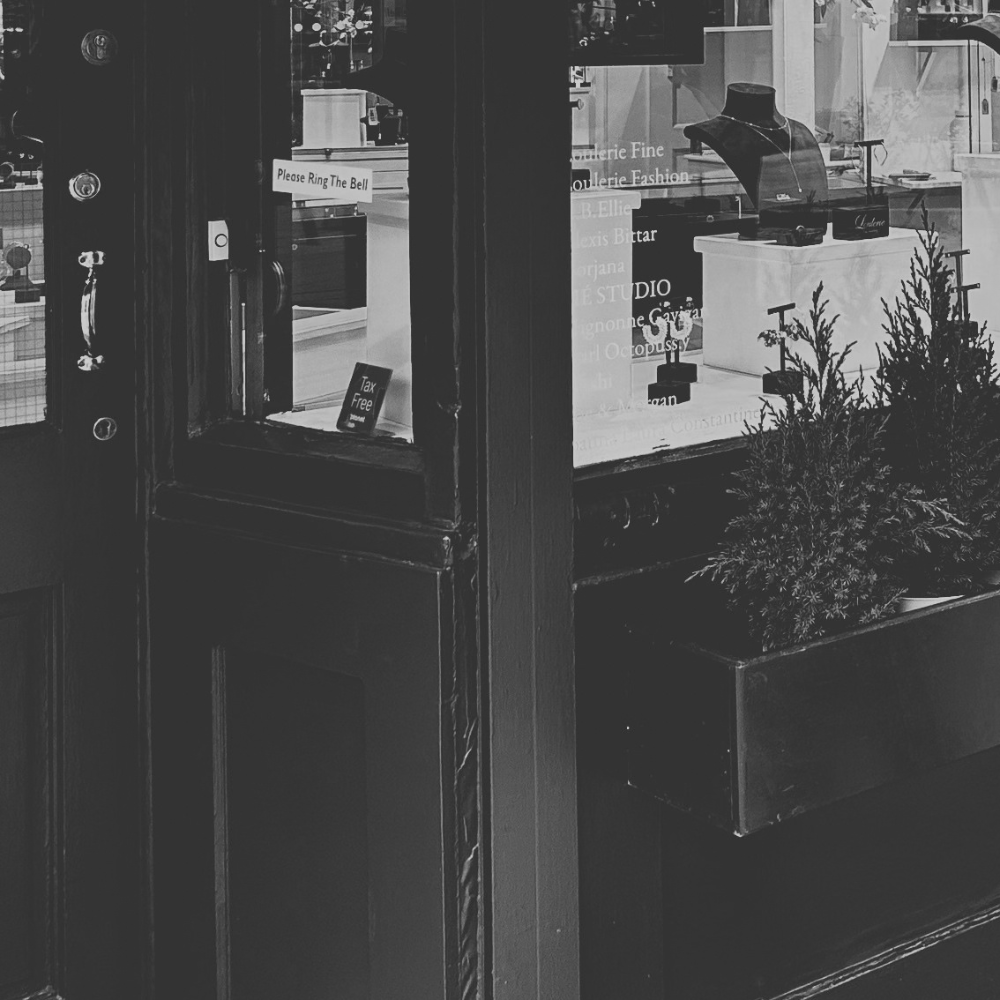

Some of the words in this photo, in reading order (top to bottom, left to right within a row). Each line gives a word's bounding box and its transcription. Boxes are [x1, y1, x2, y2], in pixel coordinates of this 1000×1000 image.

[570, 143, 627, 161] oulerie
[630, 141, 665, 158] Fine
[277, 167, 306, 184] Please
[308, 171, 329, 190] Ring
[330, 173, 347, 189] The
[350, 176, 369, 191] Bell
[570, 171, 627, 192] oulerie
[631, 167, 690, 187] Fashion
[573, 230, 609, 249] lexis
[613, 227, 658, 246] Bittar
[577, 260, 626, 282] orjana
[596, 279, 672, 305] STUDIO
[579, 314, 645, 340] ignonne
[359, 375, 377, 393] Tax
[351, 392, 373, 412] Free
